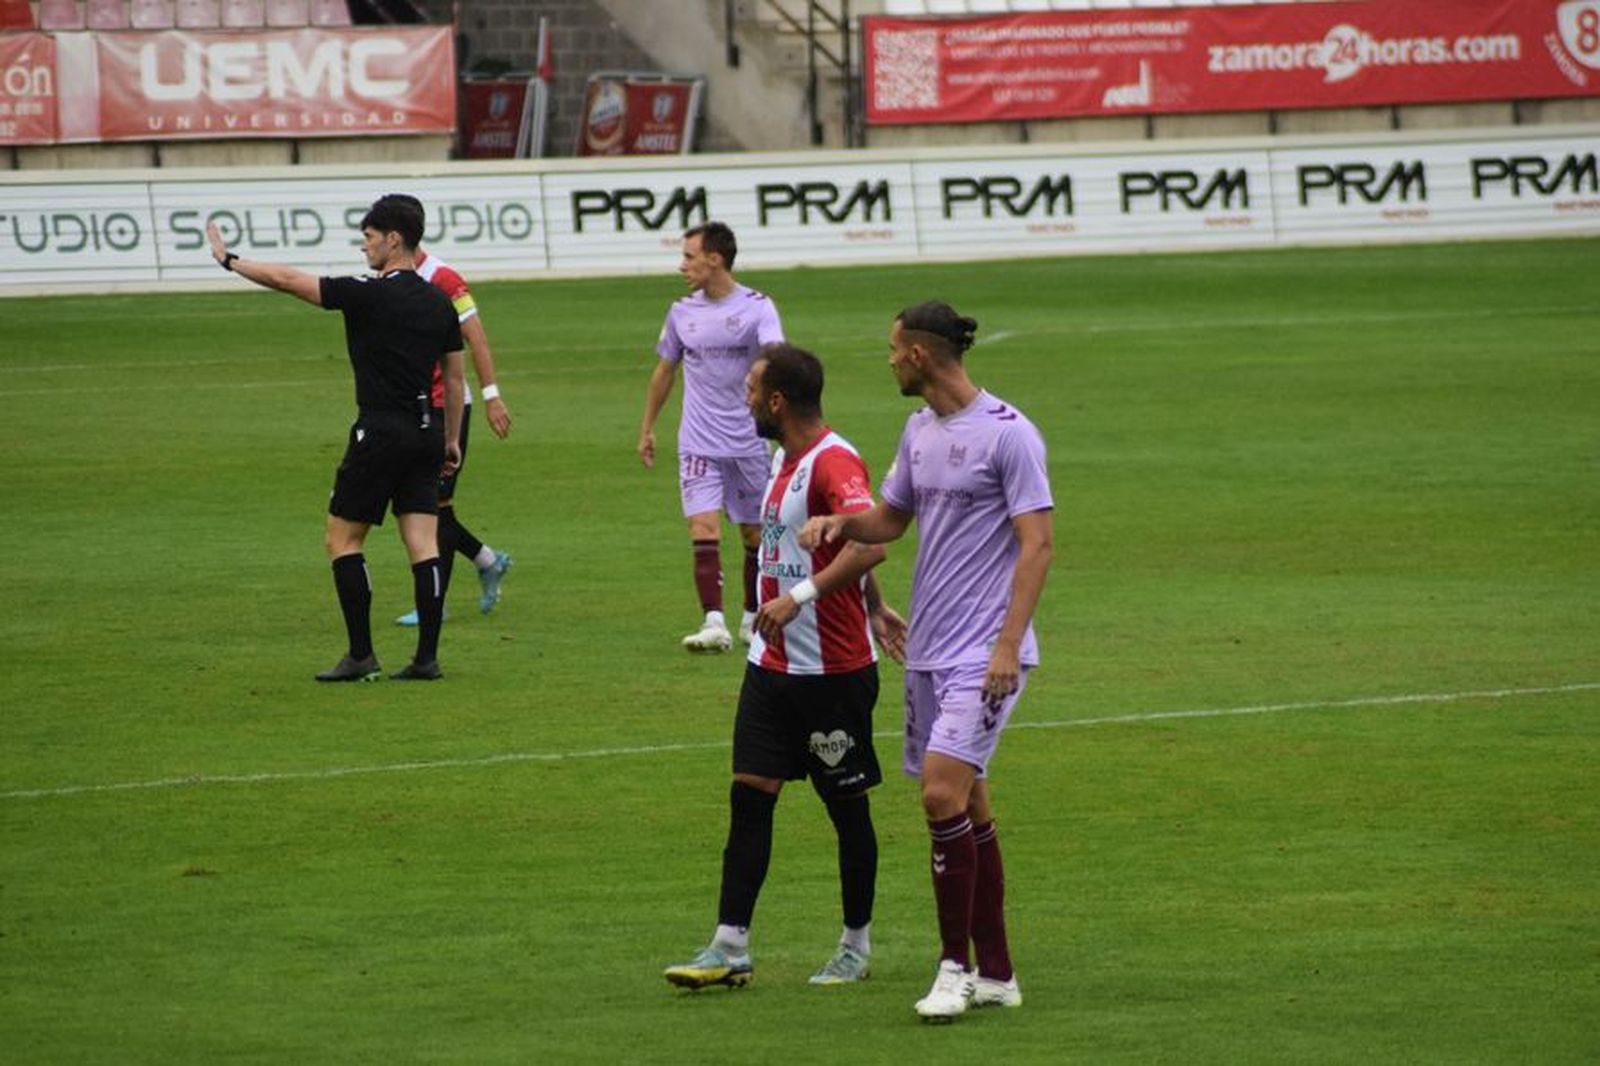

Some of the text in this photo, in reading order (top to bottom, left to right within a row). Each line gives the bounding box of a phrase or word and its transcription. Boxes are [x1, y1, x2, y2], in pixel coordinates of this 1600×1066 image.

[0, 53, 53, 96] ón
[140, 38, 410, 101] UEMC
[148, 110, 407, 131] UNIVERSIDAD
[941, 174, 1074, 219] PRM
[1119, 168, 1249, 213] PRM
[1297, 160, 1428, 206] PRM
[1471, 153, 1600, 199] PRM
[571, 186, 709, 233] PRM
[757, 179, 892, 226] PRM
[0, 213, 140, 253] UDIO
[169, 203, 532, 250] SOLID SUDIO
[685, 455, 708, 477] 10
